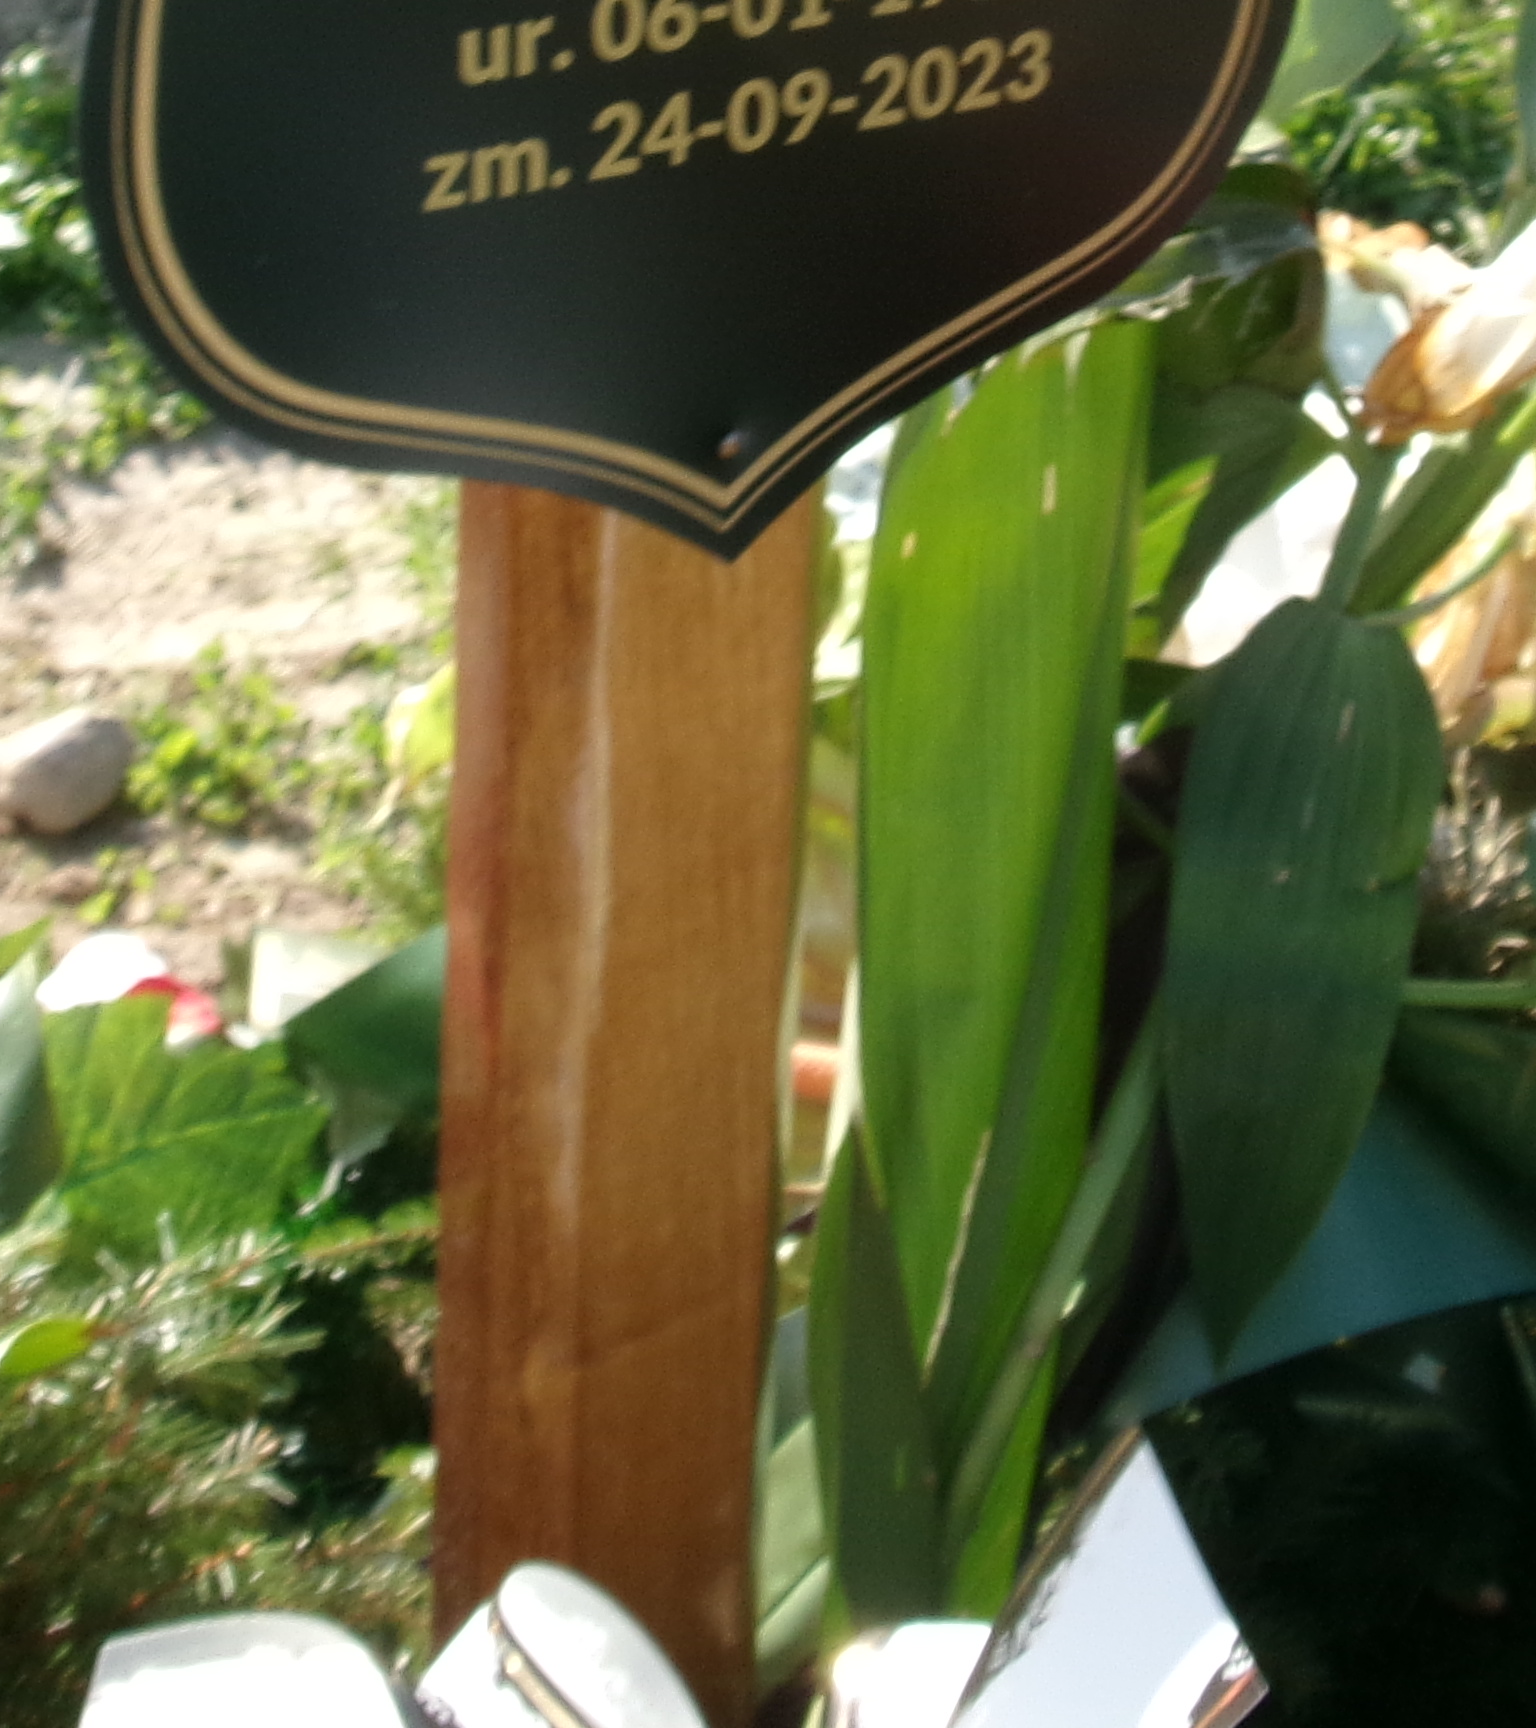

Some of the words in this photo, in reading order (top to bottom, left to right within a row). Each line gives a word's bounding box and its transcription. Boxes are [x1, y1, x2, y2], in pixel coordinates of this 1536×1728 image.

[457, 15, 575, 87] ur.
[421, 138, 572, 212] zm.
[588, 28, 1053, 181] 24-09-2023
